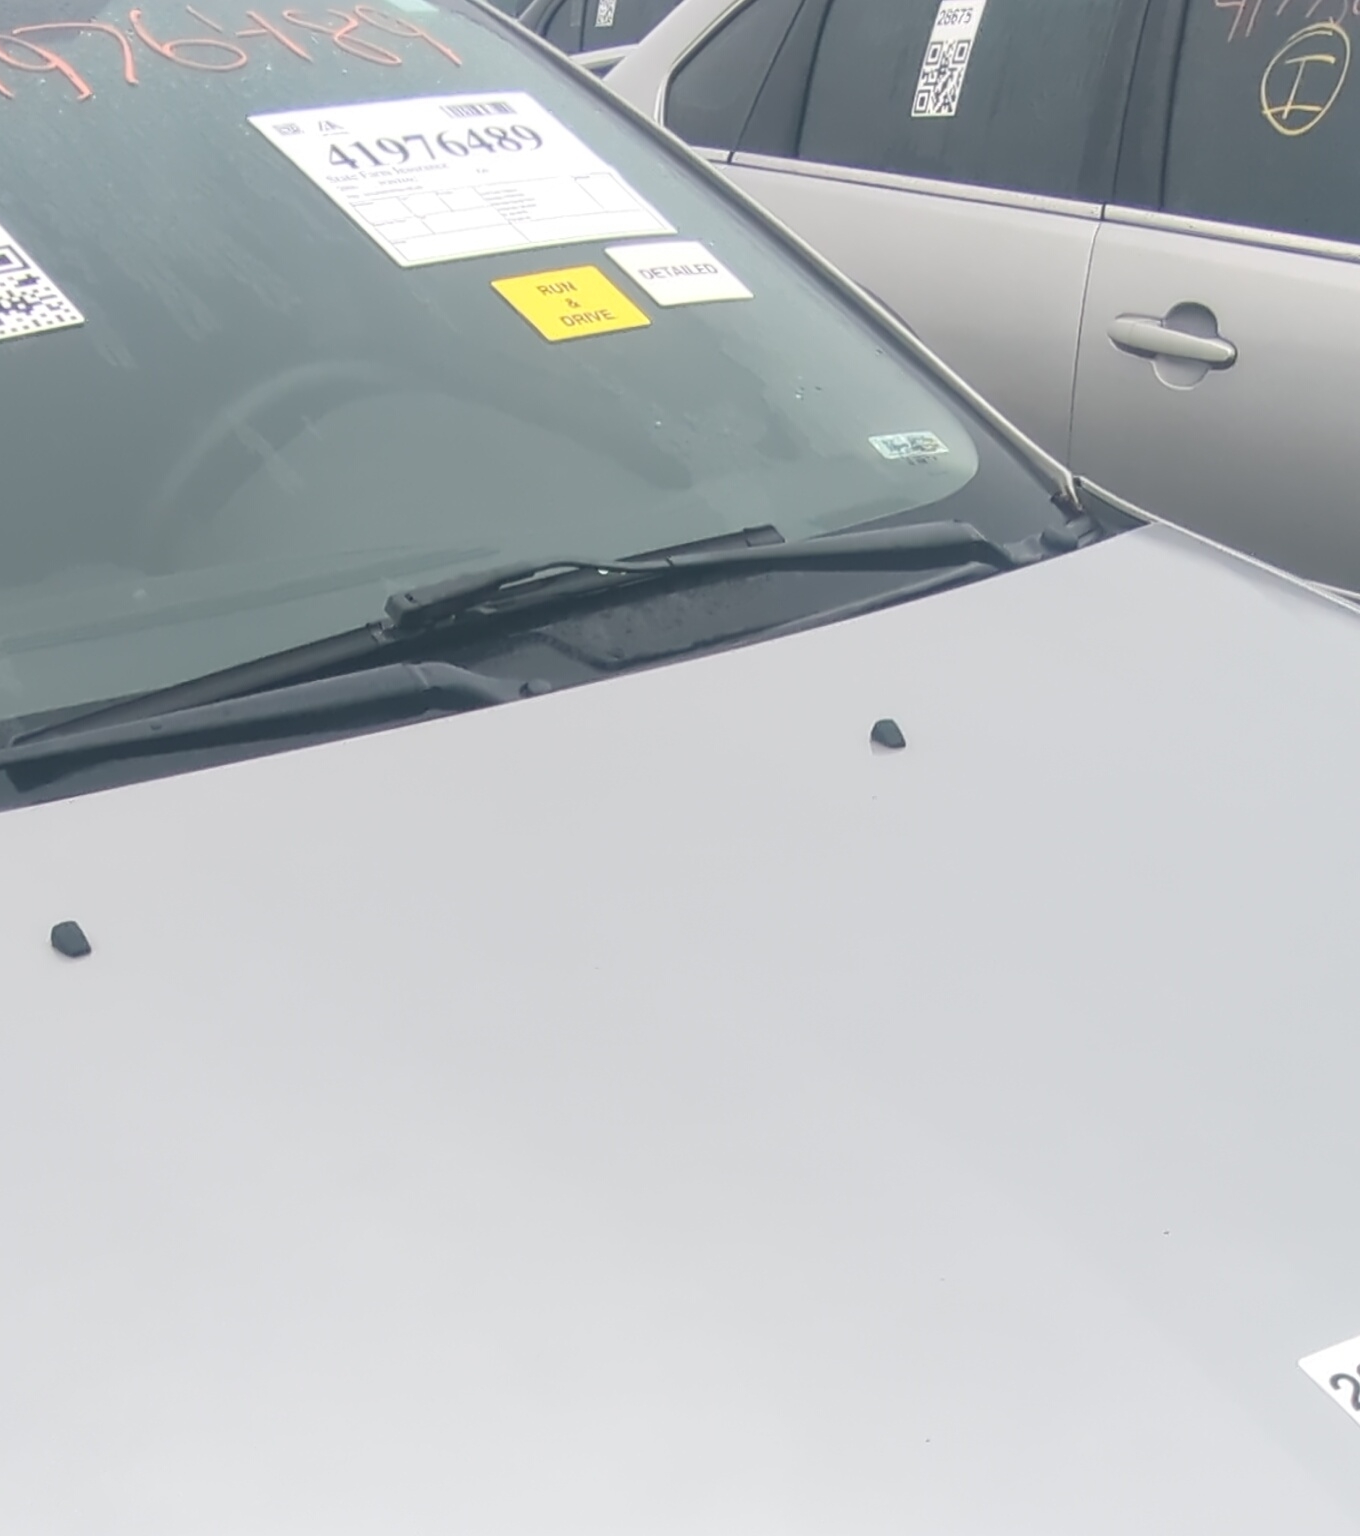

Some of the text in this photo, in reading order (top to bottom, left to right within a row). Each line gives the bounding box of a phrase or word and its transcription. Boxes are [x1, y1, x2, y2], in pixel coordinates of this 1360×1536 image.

[328, 124, 545, 169] 41976489
[638, 263, 719, 280] DETAILED
[536, 281, 577, 296] RUN
[559, 308, 618, 327] DRIVE
